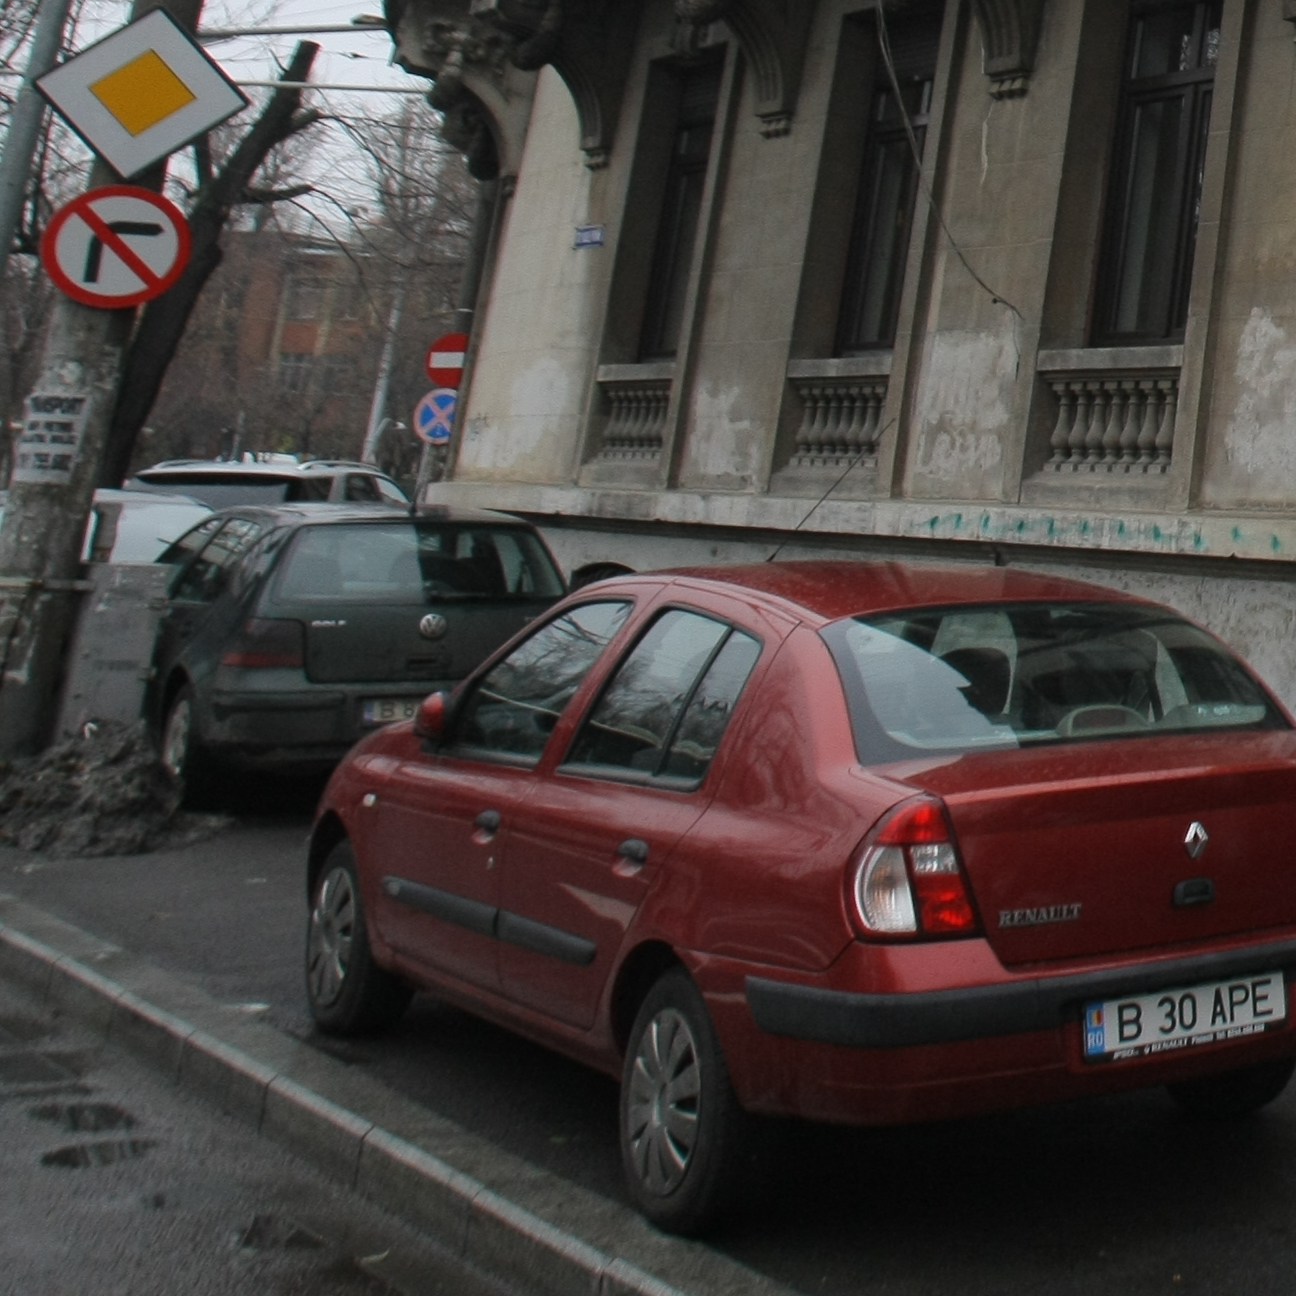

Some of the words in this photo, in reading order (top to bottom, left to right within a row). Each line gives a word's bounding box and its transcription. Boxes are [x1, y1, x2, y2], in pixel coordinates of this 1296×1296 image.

[998, 902, 1082, 929] RENAULT
[1087, 1031, 1104, 1049] RO
[1117, 1002, 1143, 1043] B
[1157, 991, 1198, 1035] 30
[1210, 978, 1274, 1027] APE
